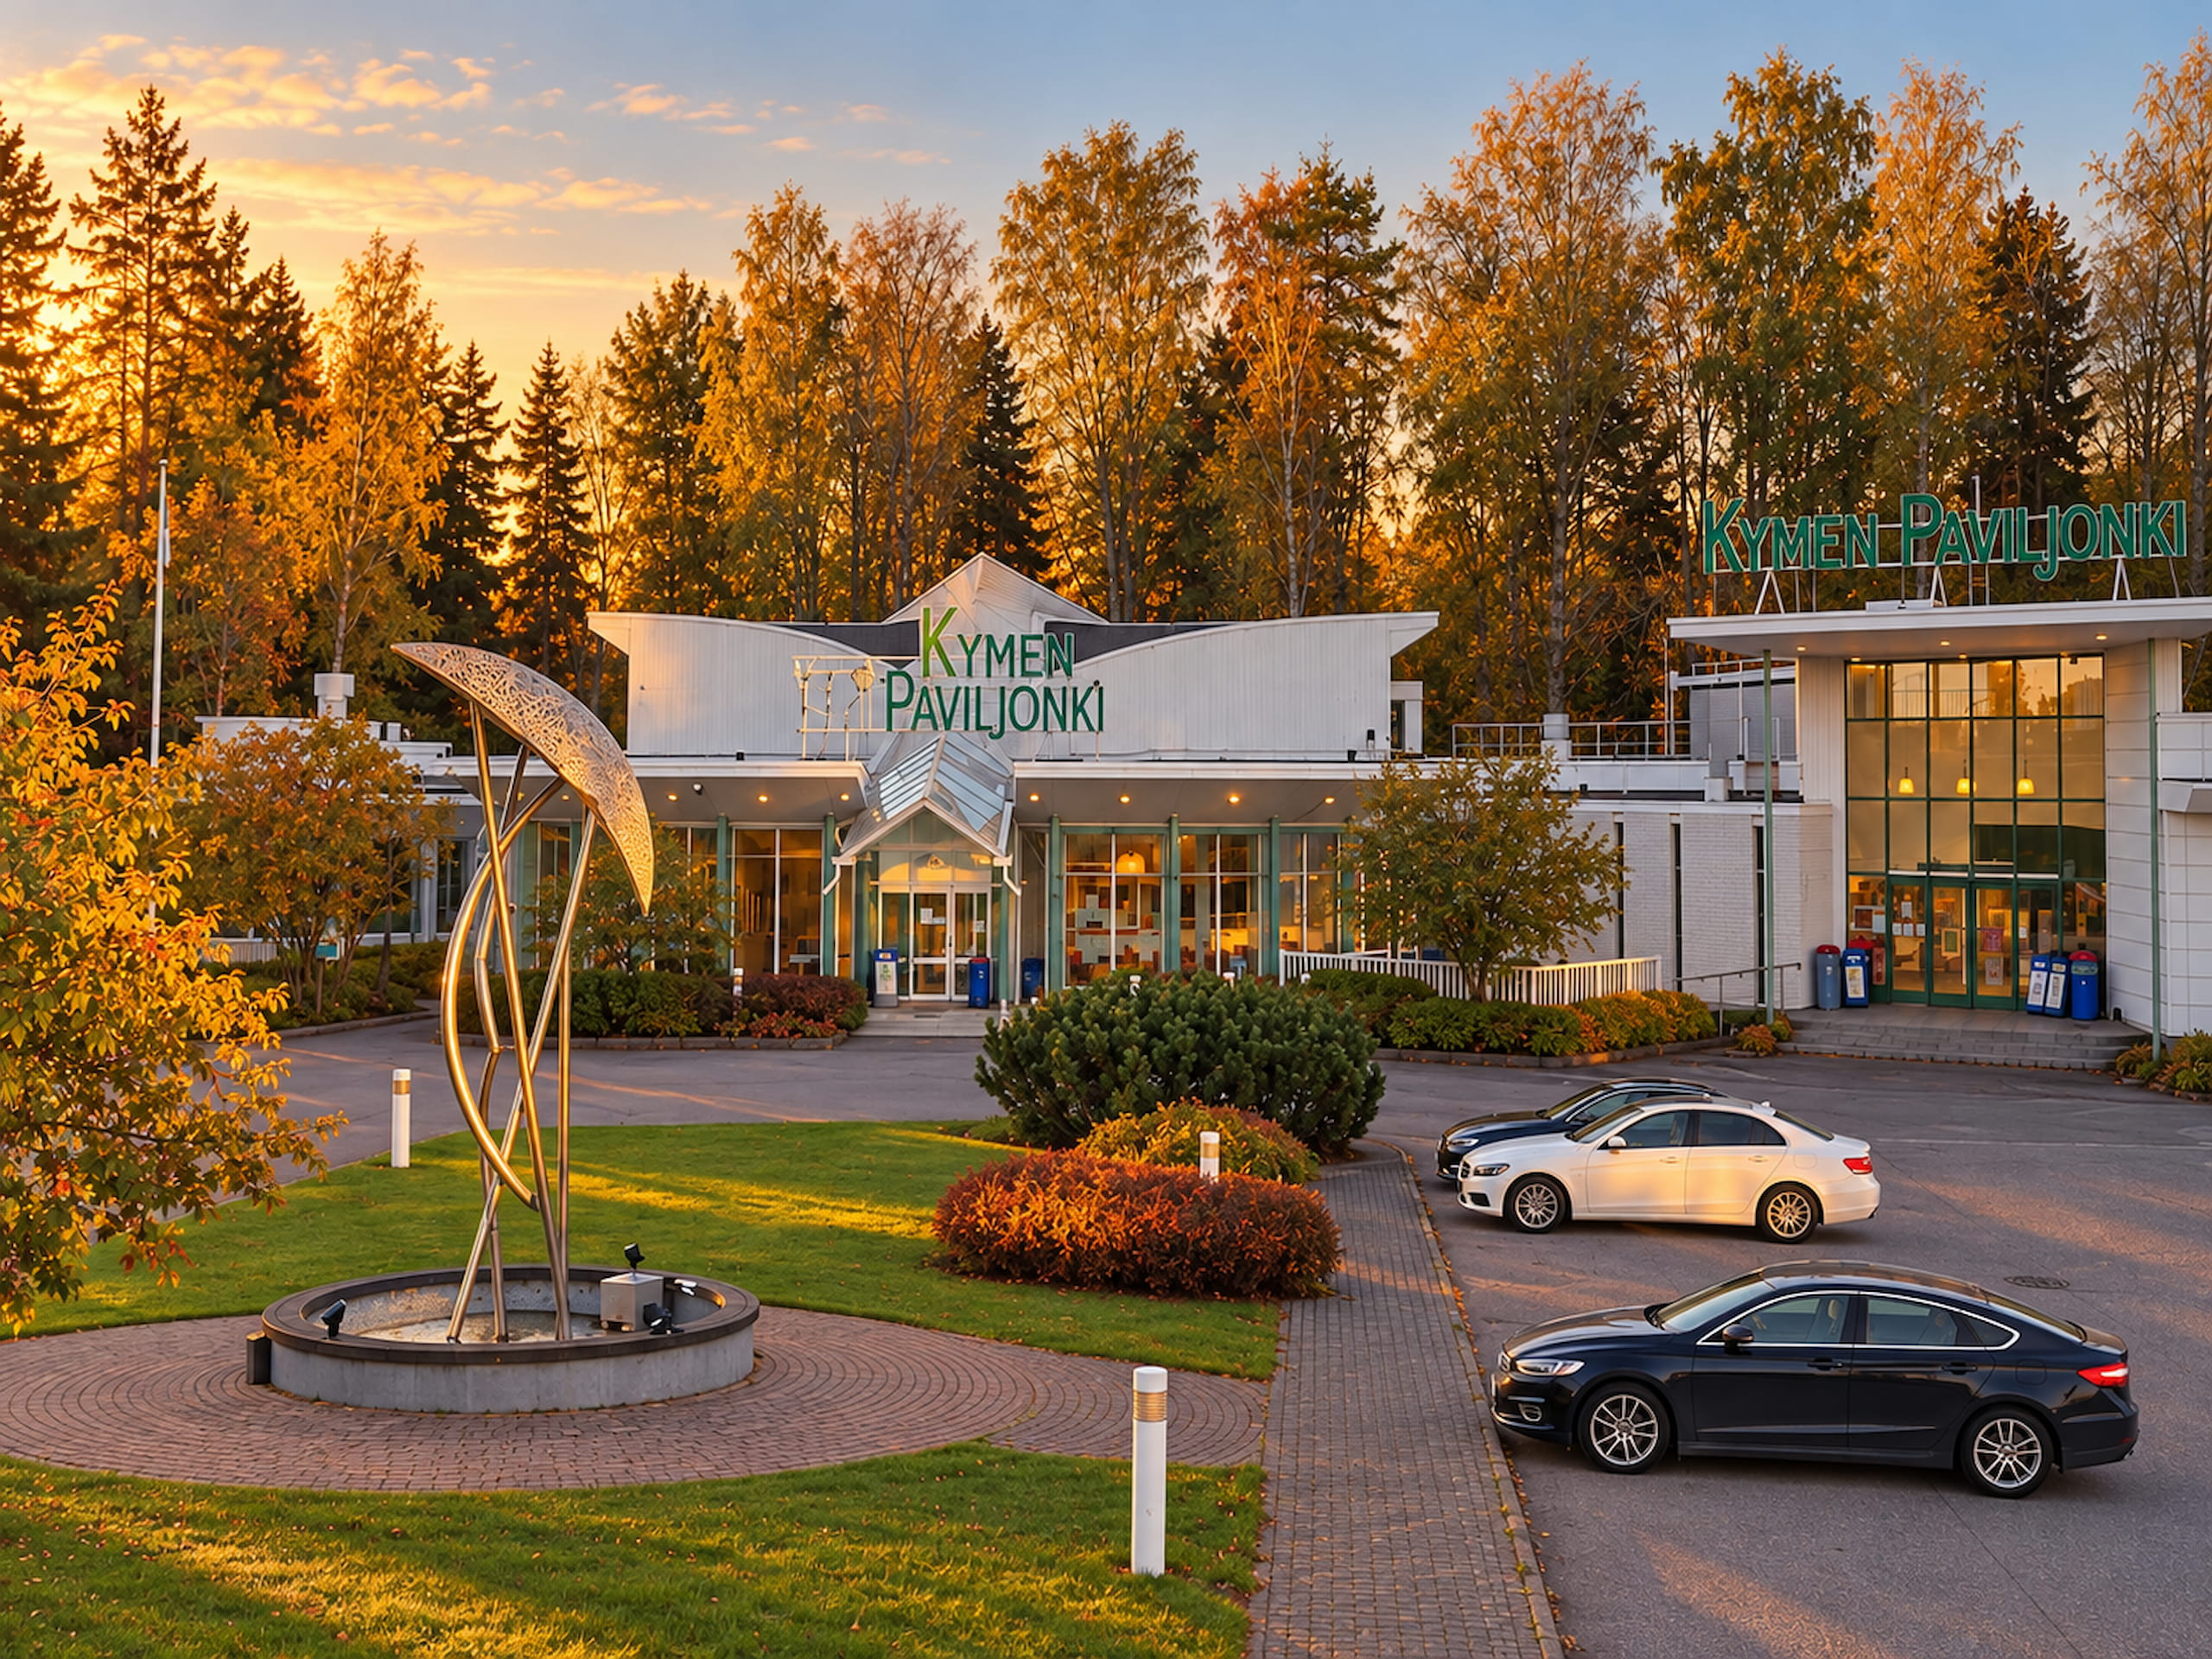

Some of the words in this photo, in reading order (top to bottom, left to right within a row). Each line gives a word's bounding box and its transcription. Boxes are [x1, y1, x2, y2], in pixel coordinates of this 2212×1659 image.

[1703, 497, 1878, 574] KYMEN
[1901, 493, 2186, 581] PAVILJONKI
[921, 607, 1074, 678] KYMEN
[887, 671, 1103, 740] PAVILJONKI
